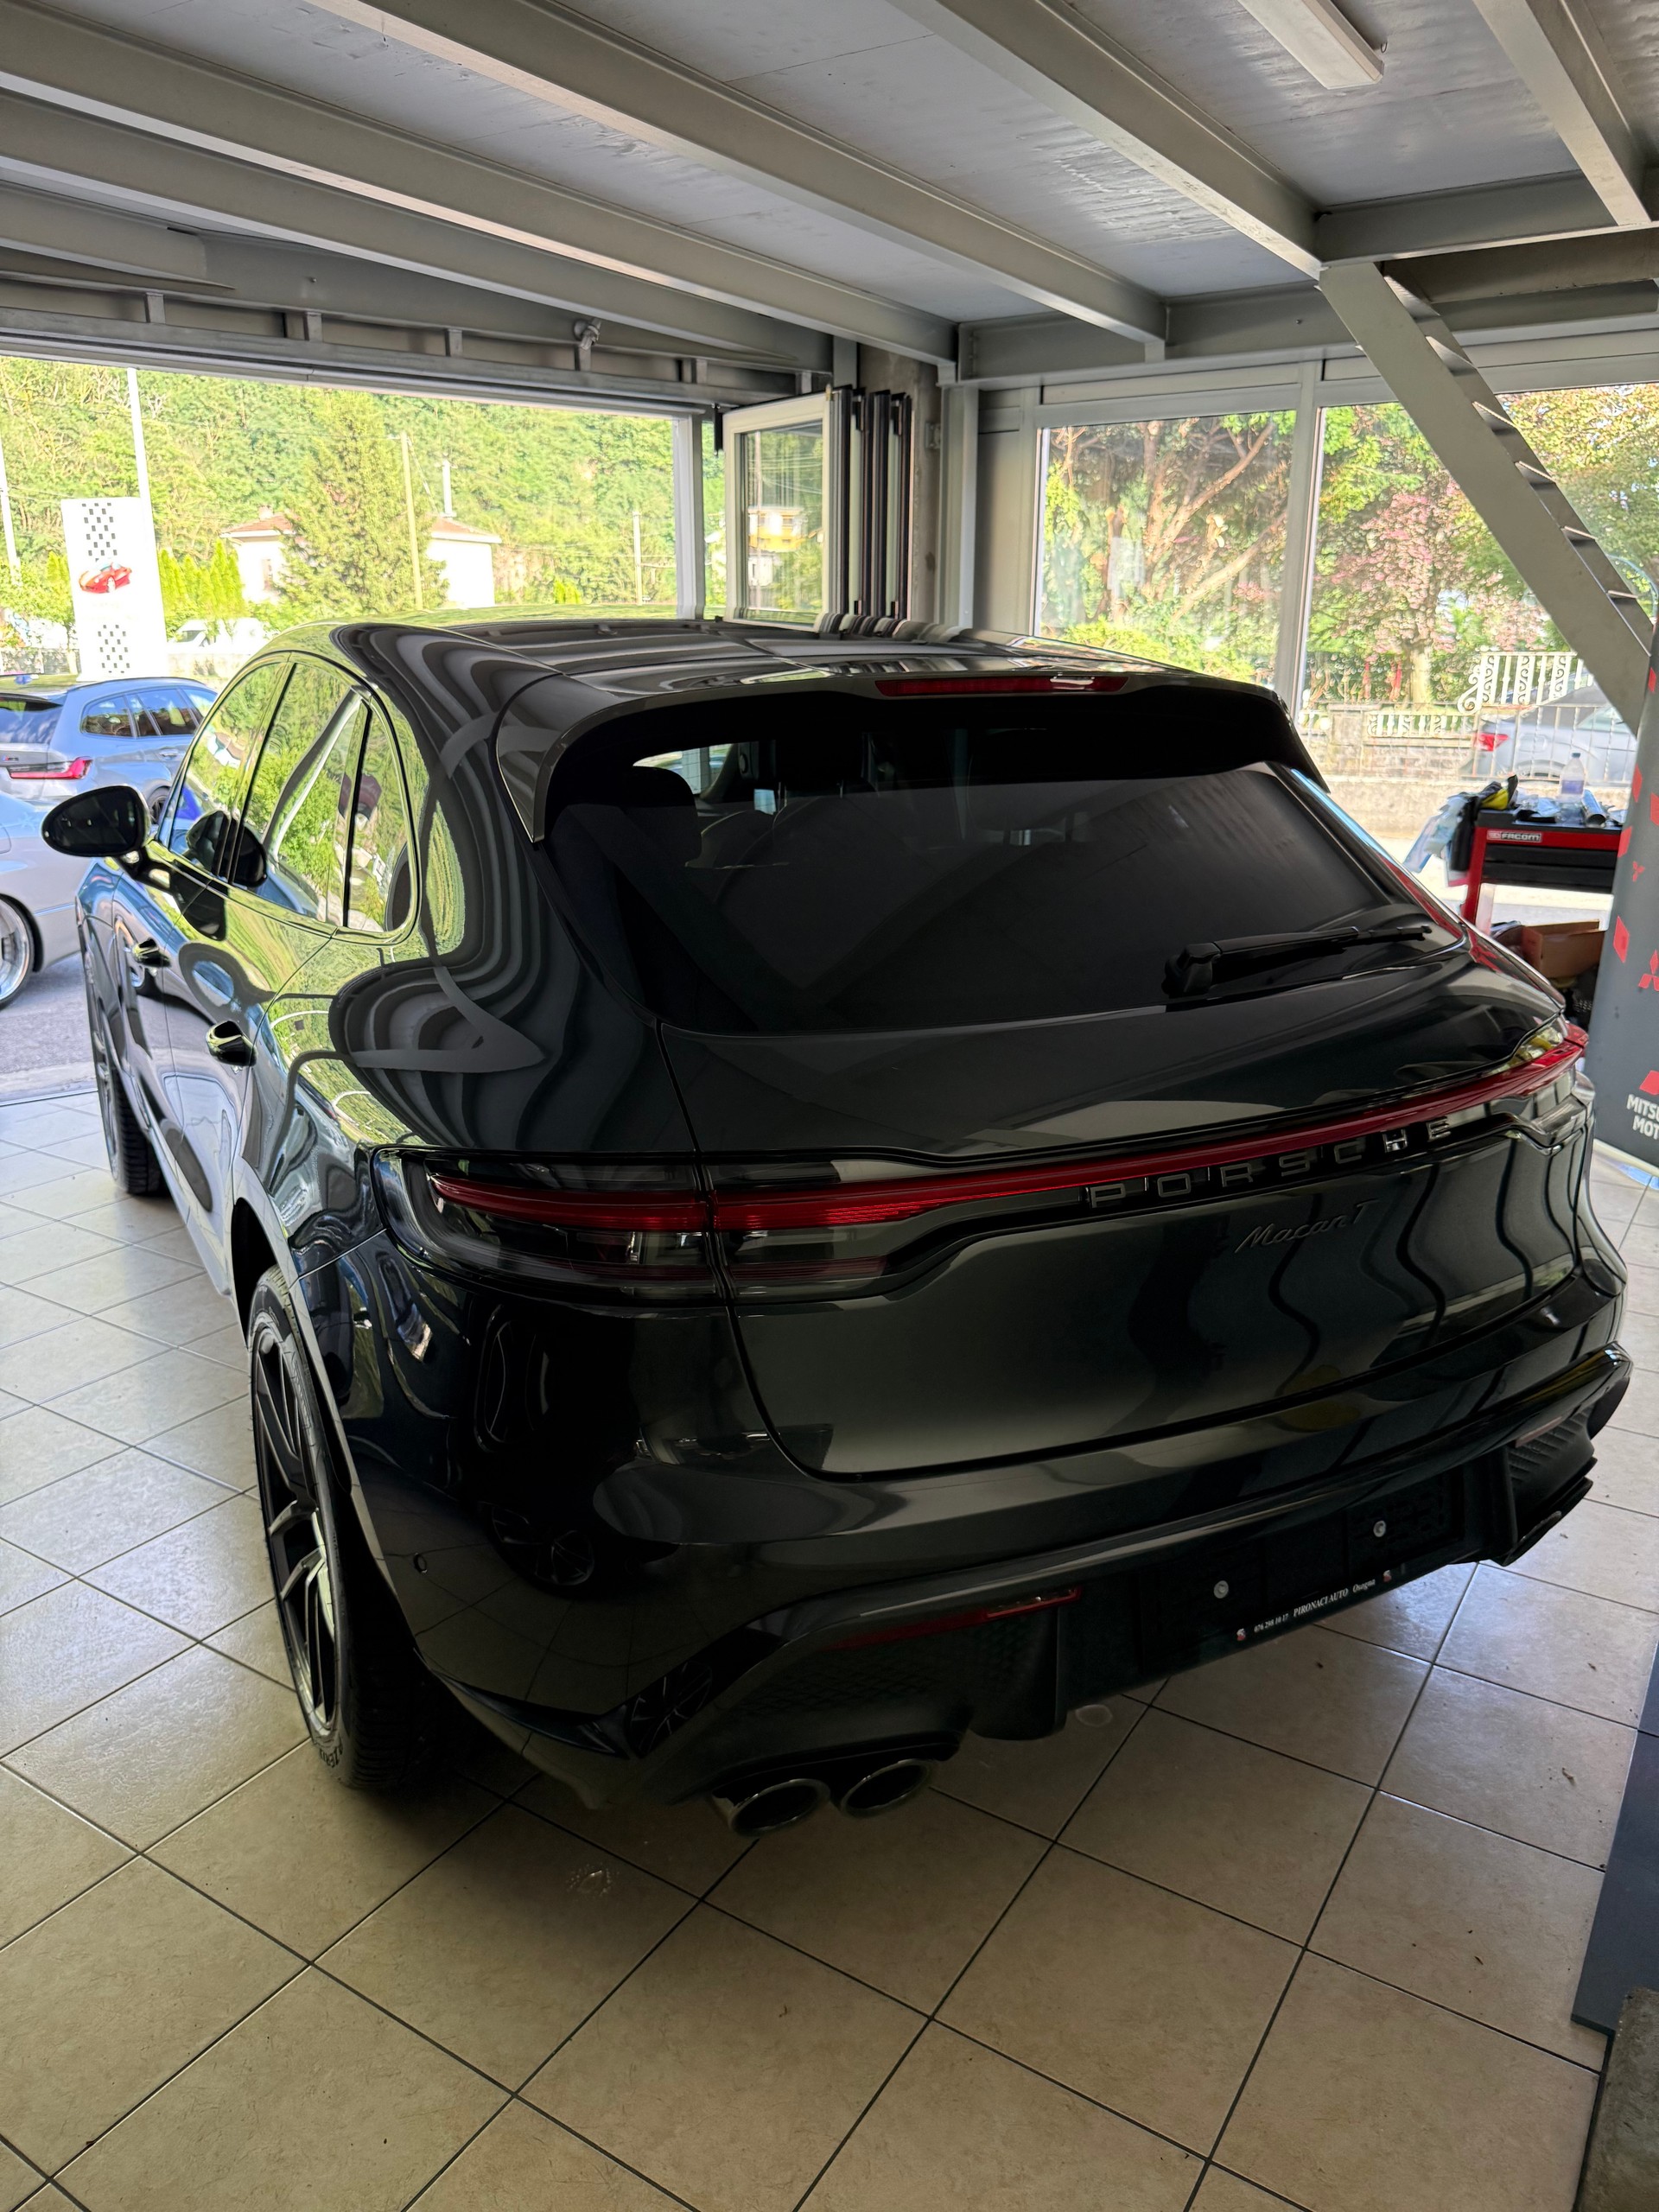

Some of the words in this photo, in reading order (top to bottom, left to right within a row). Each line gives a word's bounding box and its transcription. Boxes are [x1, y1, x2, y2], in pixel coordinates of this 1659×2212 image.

[1090, 1118, 1452, 1208] PORSCHE
[1234, 1214, 1348, 1254] Macan
[1353, 1198, 1380, 1224] T
[1294, 1595, 1329, 1618] PIRONACI
[1329, 1587, 1349, 1604] AUTO
